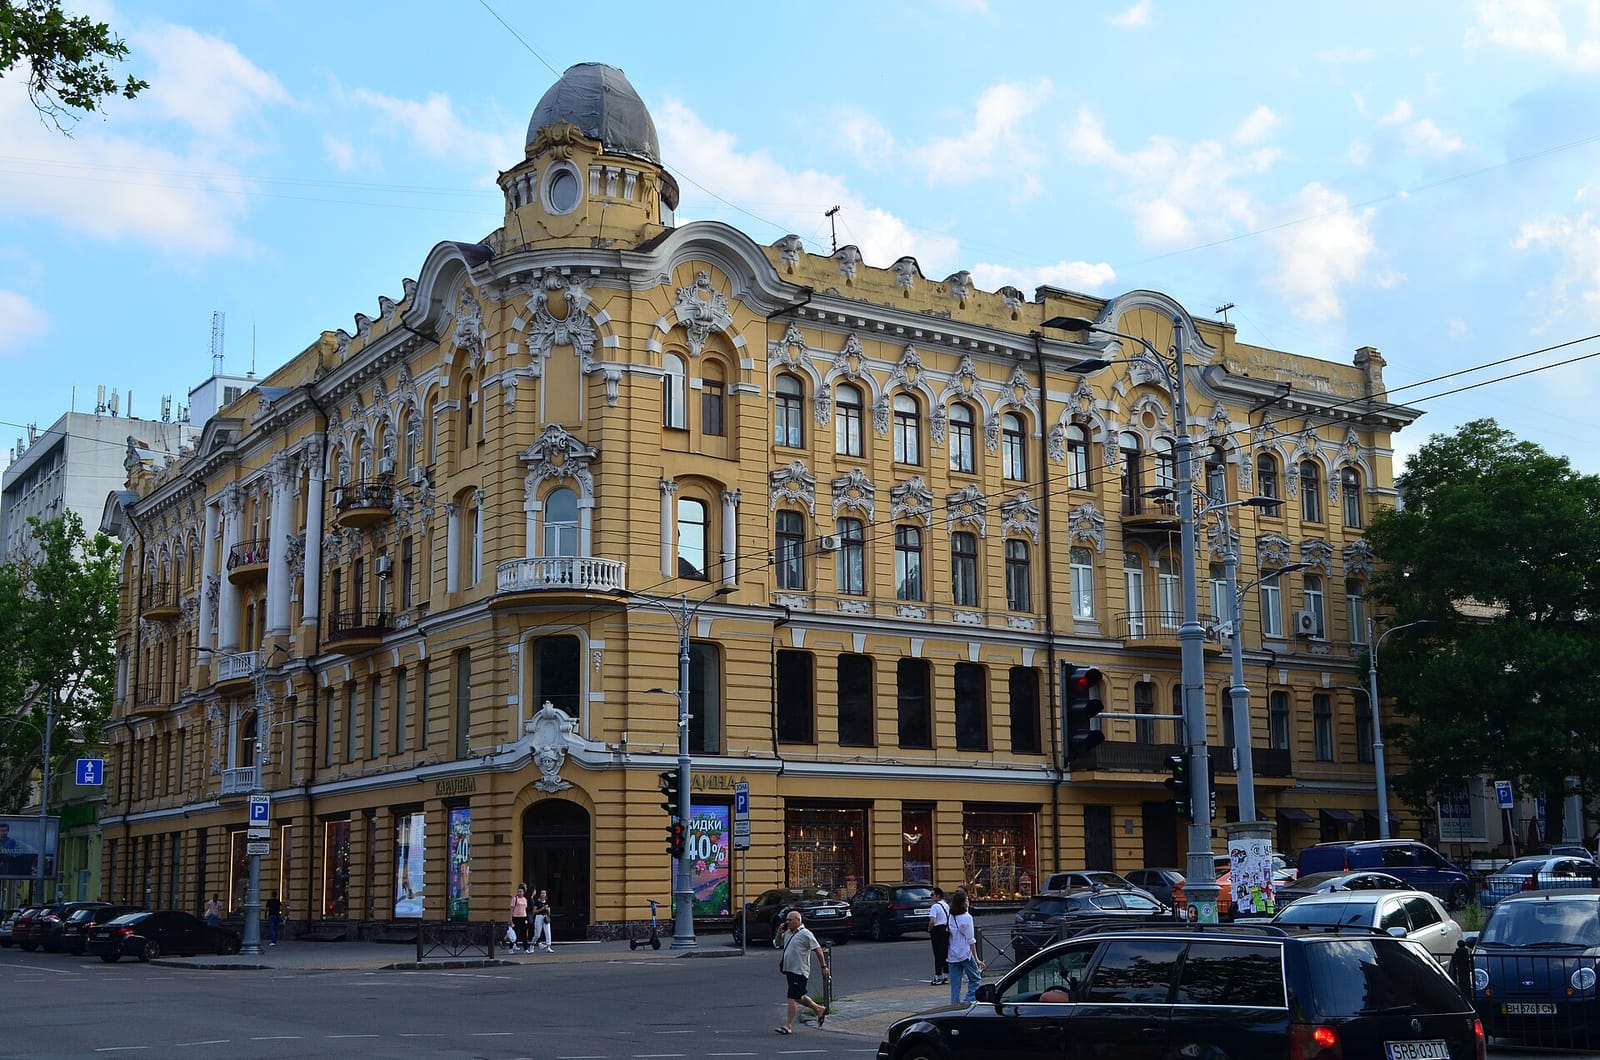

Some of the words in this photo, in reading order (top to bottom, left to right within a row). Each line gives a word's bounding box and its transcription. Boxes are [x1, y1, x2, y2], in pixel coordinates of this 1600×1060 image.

[435, 777, 476, 795] КАРДИНАЛ
[658, 773, 747, 791] КДИНА
[736, 783, 747, 791] ЗОНА
[738, 795, 745, 811] P
[1500, 789, 1508, 801] P
[255, 805, 265, 818] P
[1392, 1043, 1418, 1060] SRB
